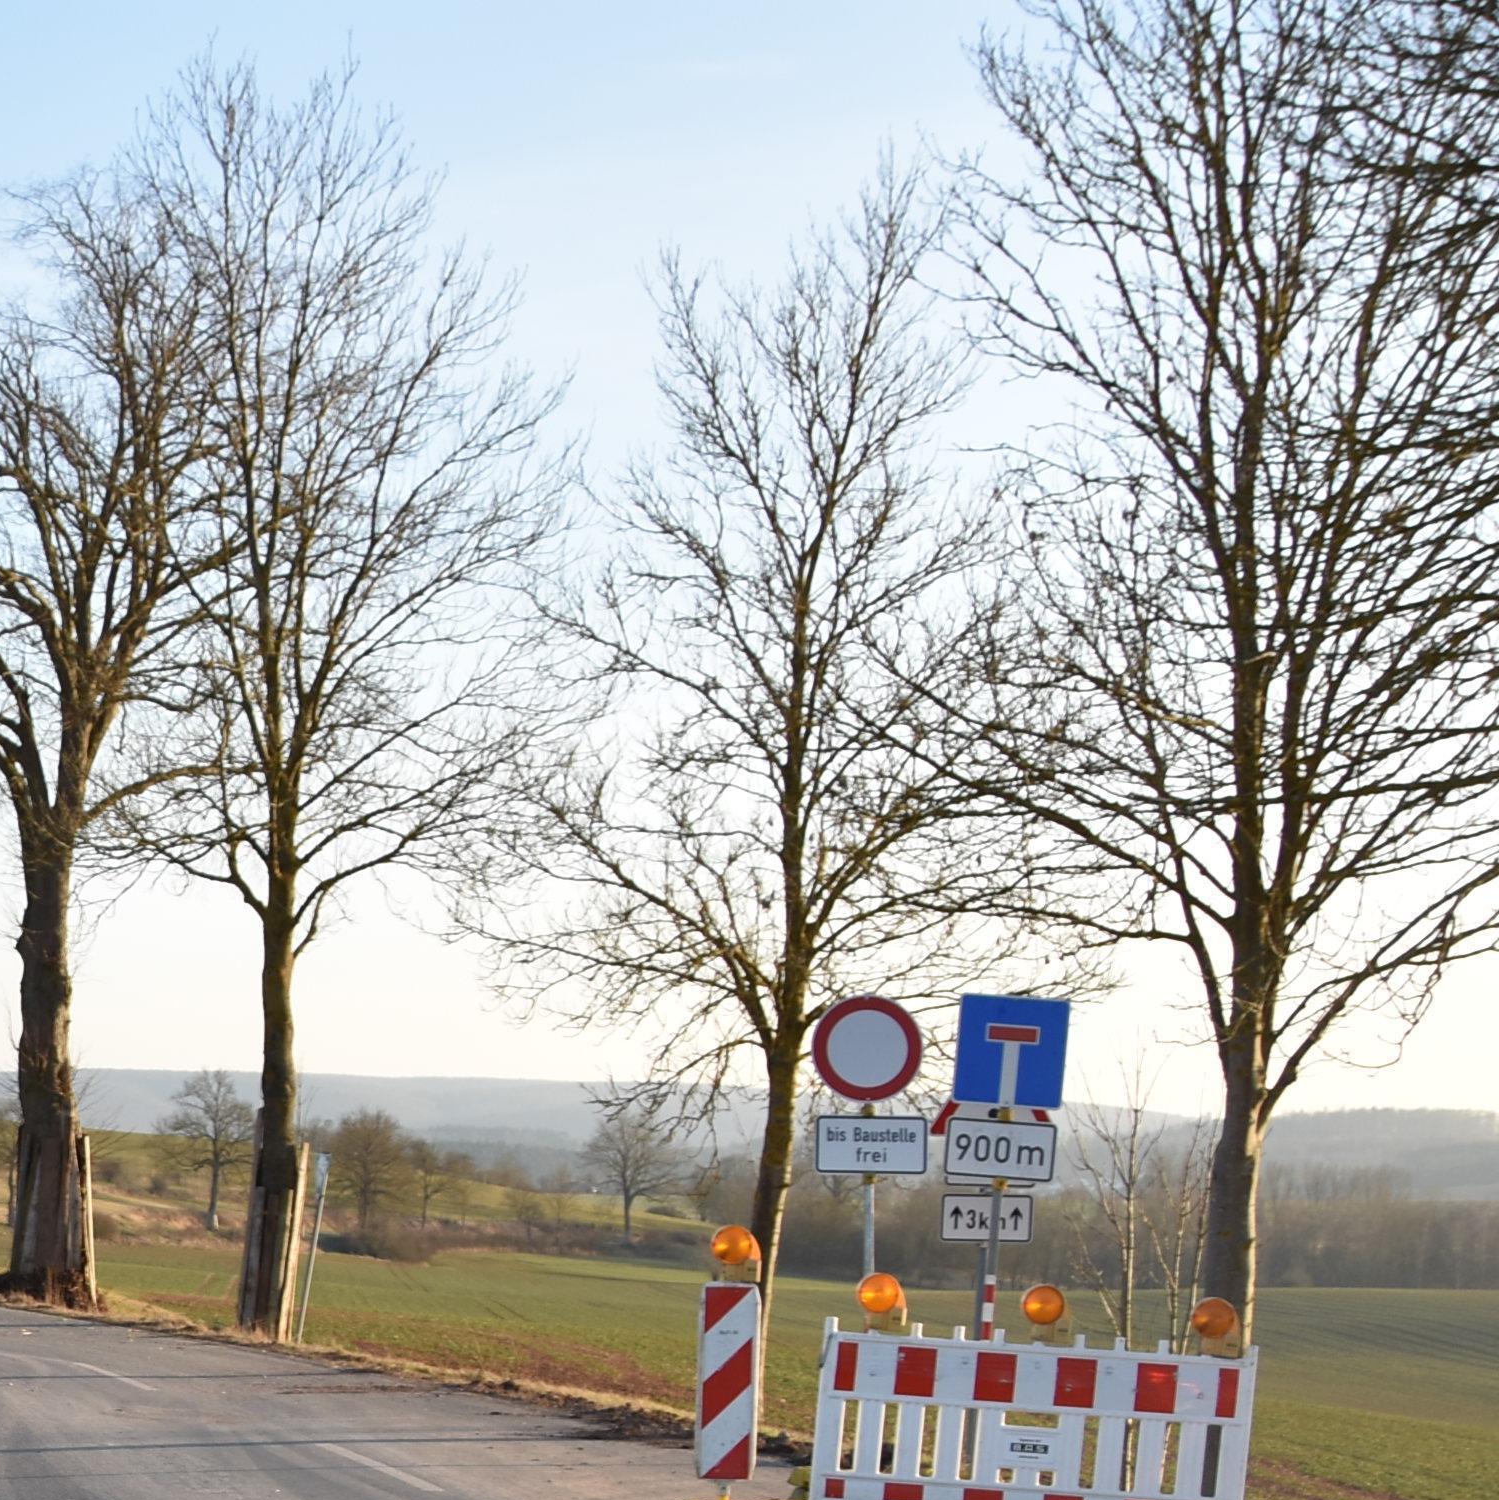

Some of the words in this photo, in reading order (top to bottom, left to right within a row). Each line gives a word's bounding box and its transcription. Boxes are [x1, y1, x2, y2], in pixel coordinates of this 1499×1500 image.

[826, 1126, 847, 1142] bis
[853, 1126, 917, 1143] Baustelle
[856, 1147, 887, 1163] frei
[955, 1133, 1011, 1164] 900
[1016, 1145, 1045, 1167] m
